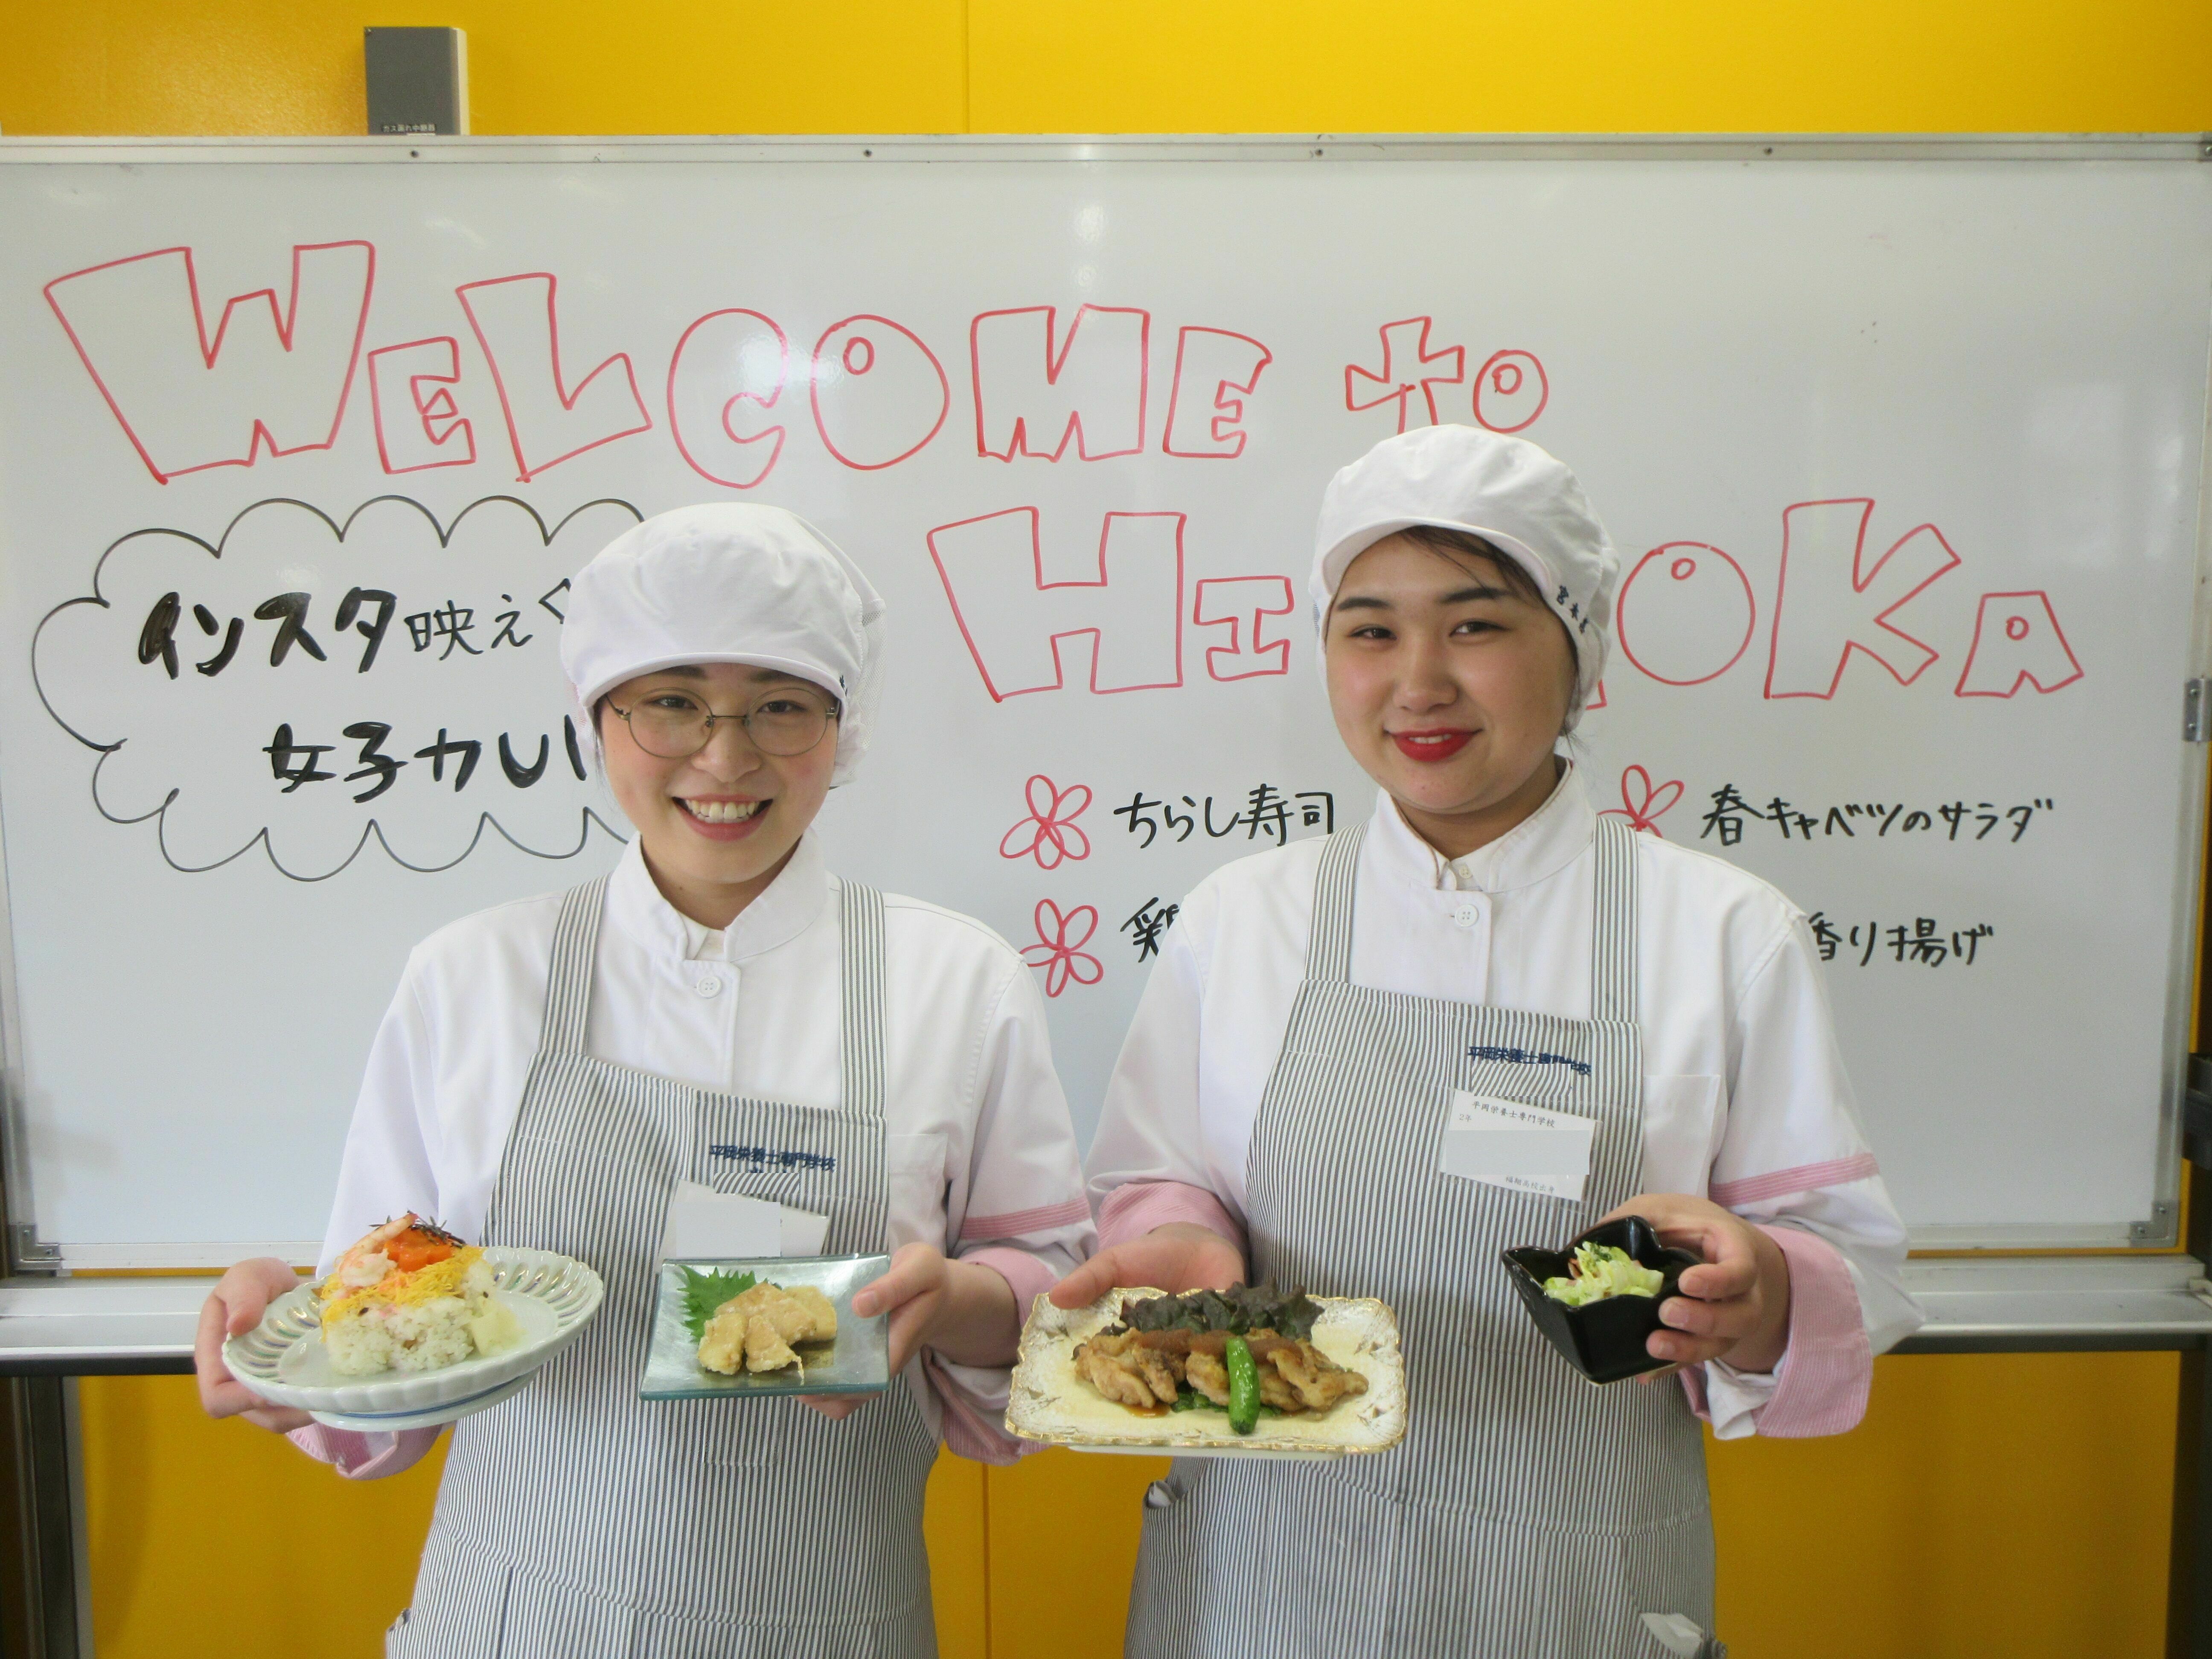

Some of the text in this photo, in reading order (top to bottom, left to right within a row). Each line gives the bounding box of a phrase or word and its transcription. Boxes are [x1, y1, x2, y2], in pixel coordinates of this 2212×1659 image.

[44, 240, 1273, 489] WELCOME
[138, 587, 533, 680] インスタ映え
[1113, 783, 1334, 847] ちらし寿司
[1700, 783, 2053, 846] 春キャベツのサラダ
